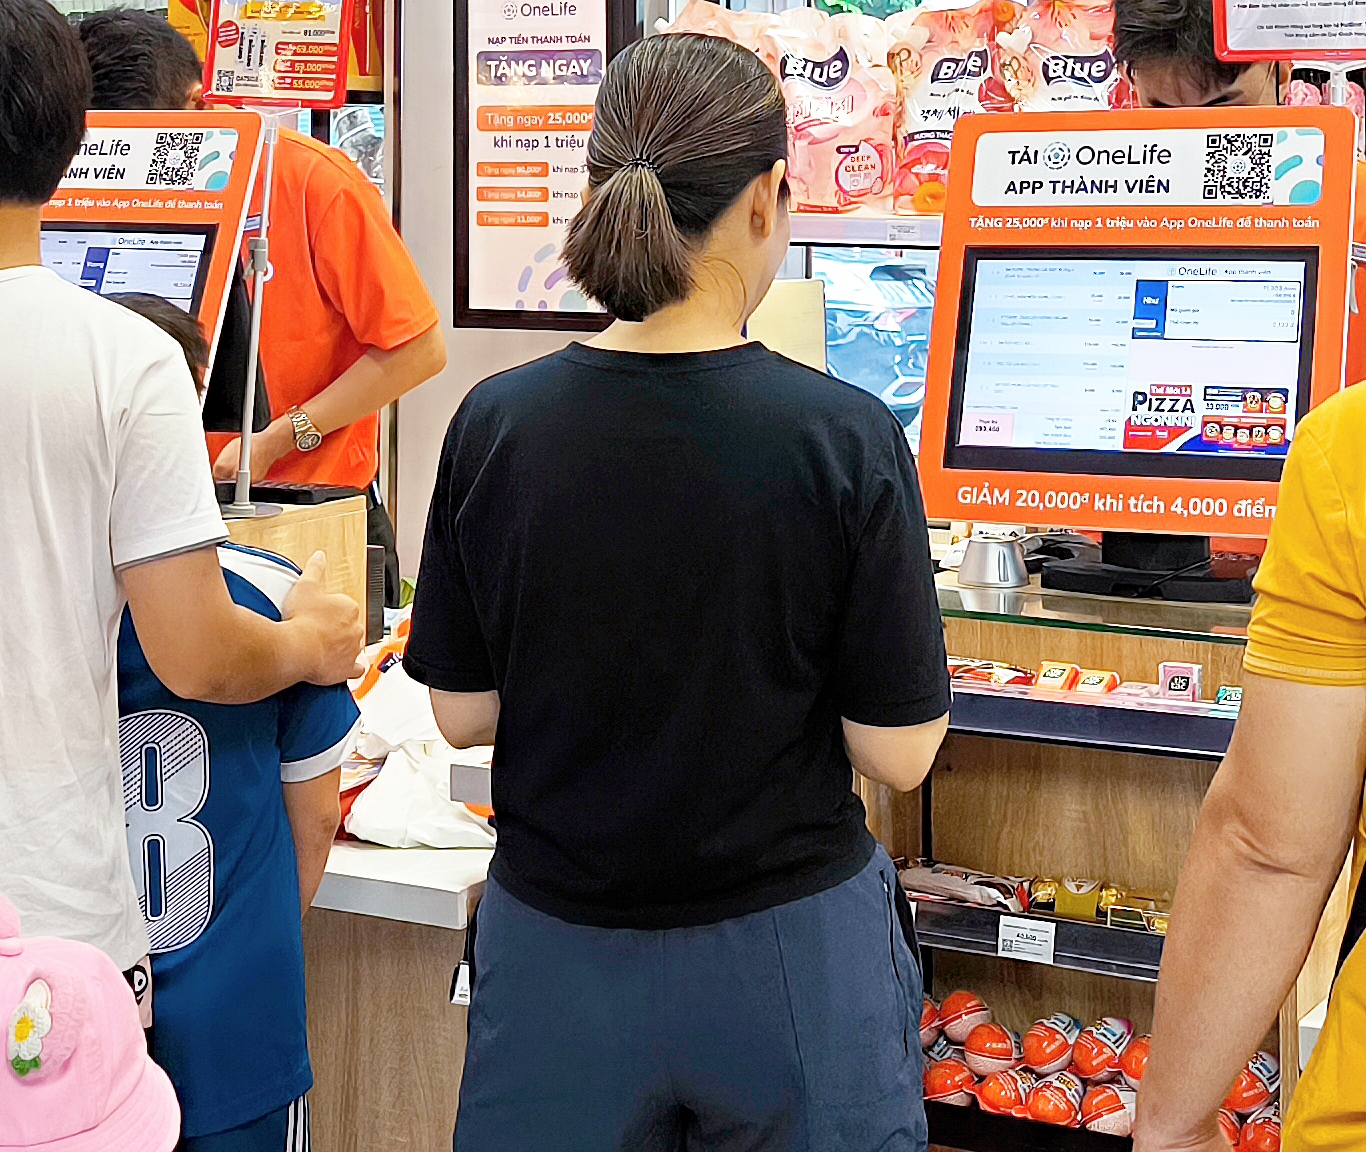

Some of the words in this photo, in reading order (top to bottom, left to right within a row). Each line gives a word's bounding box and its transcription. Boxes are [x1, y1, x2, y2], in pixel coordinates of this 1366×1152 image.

[520, 1, 577, 18] OneLife
[531, 35, 563, 44] THANH
[566, 32, 591, 44] TOÁN
[487, 55, 537, 82] TẶNG
[541, 59, 592, 76] NGAY
[785, 51, 842, 87] Blue
[1048, 58, 1107, 79] Blue
[517, 114, 544, 127] ngay
[77, 139, 131, 156] neLife
[493, 134, 512, 149] khi
[515, 137, 539, 152] nạp
[543, 135, 551, 148] 1
[555, 134, 584, 151] triệu
[1007, 145, 1039, 166] TẢI
[1075, 143, 1172, 166] OneLife
[93, 164, 126, 180] VIÊN
[844, 164, 876, 173] CLEAN
[1004, 180, 1043, 196] APP
[1048, 175, 1118, 195] THÀNH
[1124, 173, 1170, 194] VIÊN
[113, 200, 129, 210] App
[132, 198, 164, 208] OneLife
[177, 199, 203, 209] thanh
[969, 215, 1003, 231] TẶNG
[1050, 217, 1068, 228] khi
[1070, 220, 1092, 231] nạp
[1095, 217, 1103, 228] 1
[1106, 216, 1134, 231] triệu
[1136, 216, 1158, 228] vào
[1159, 217, 1185, 230] App
[1187, 216, 1234, 228] OneLife
[1254, 217, 1290, 228] thanh
[1292, 215, 1320, 228] toán
[1132, 391, 1196, 414] PIZZA
[957, 482, 1010, 508] GIẢM
[1093, 492, 1125, 512] khi
[1128, 495, 1165, 515] tích
[1170, 497, 1227, 519] 4,000
[119, 708, 214, 955] 8
